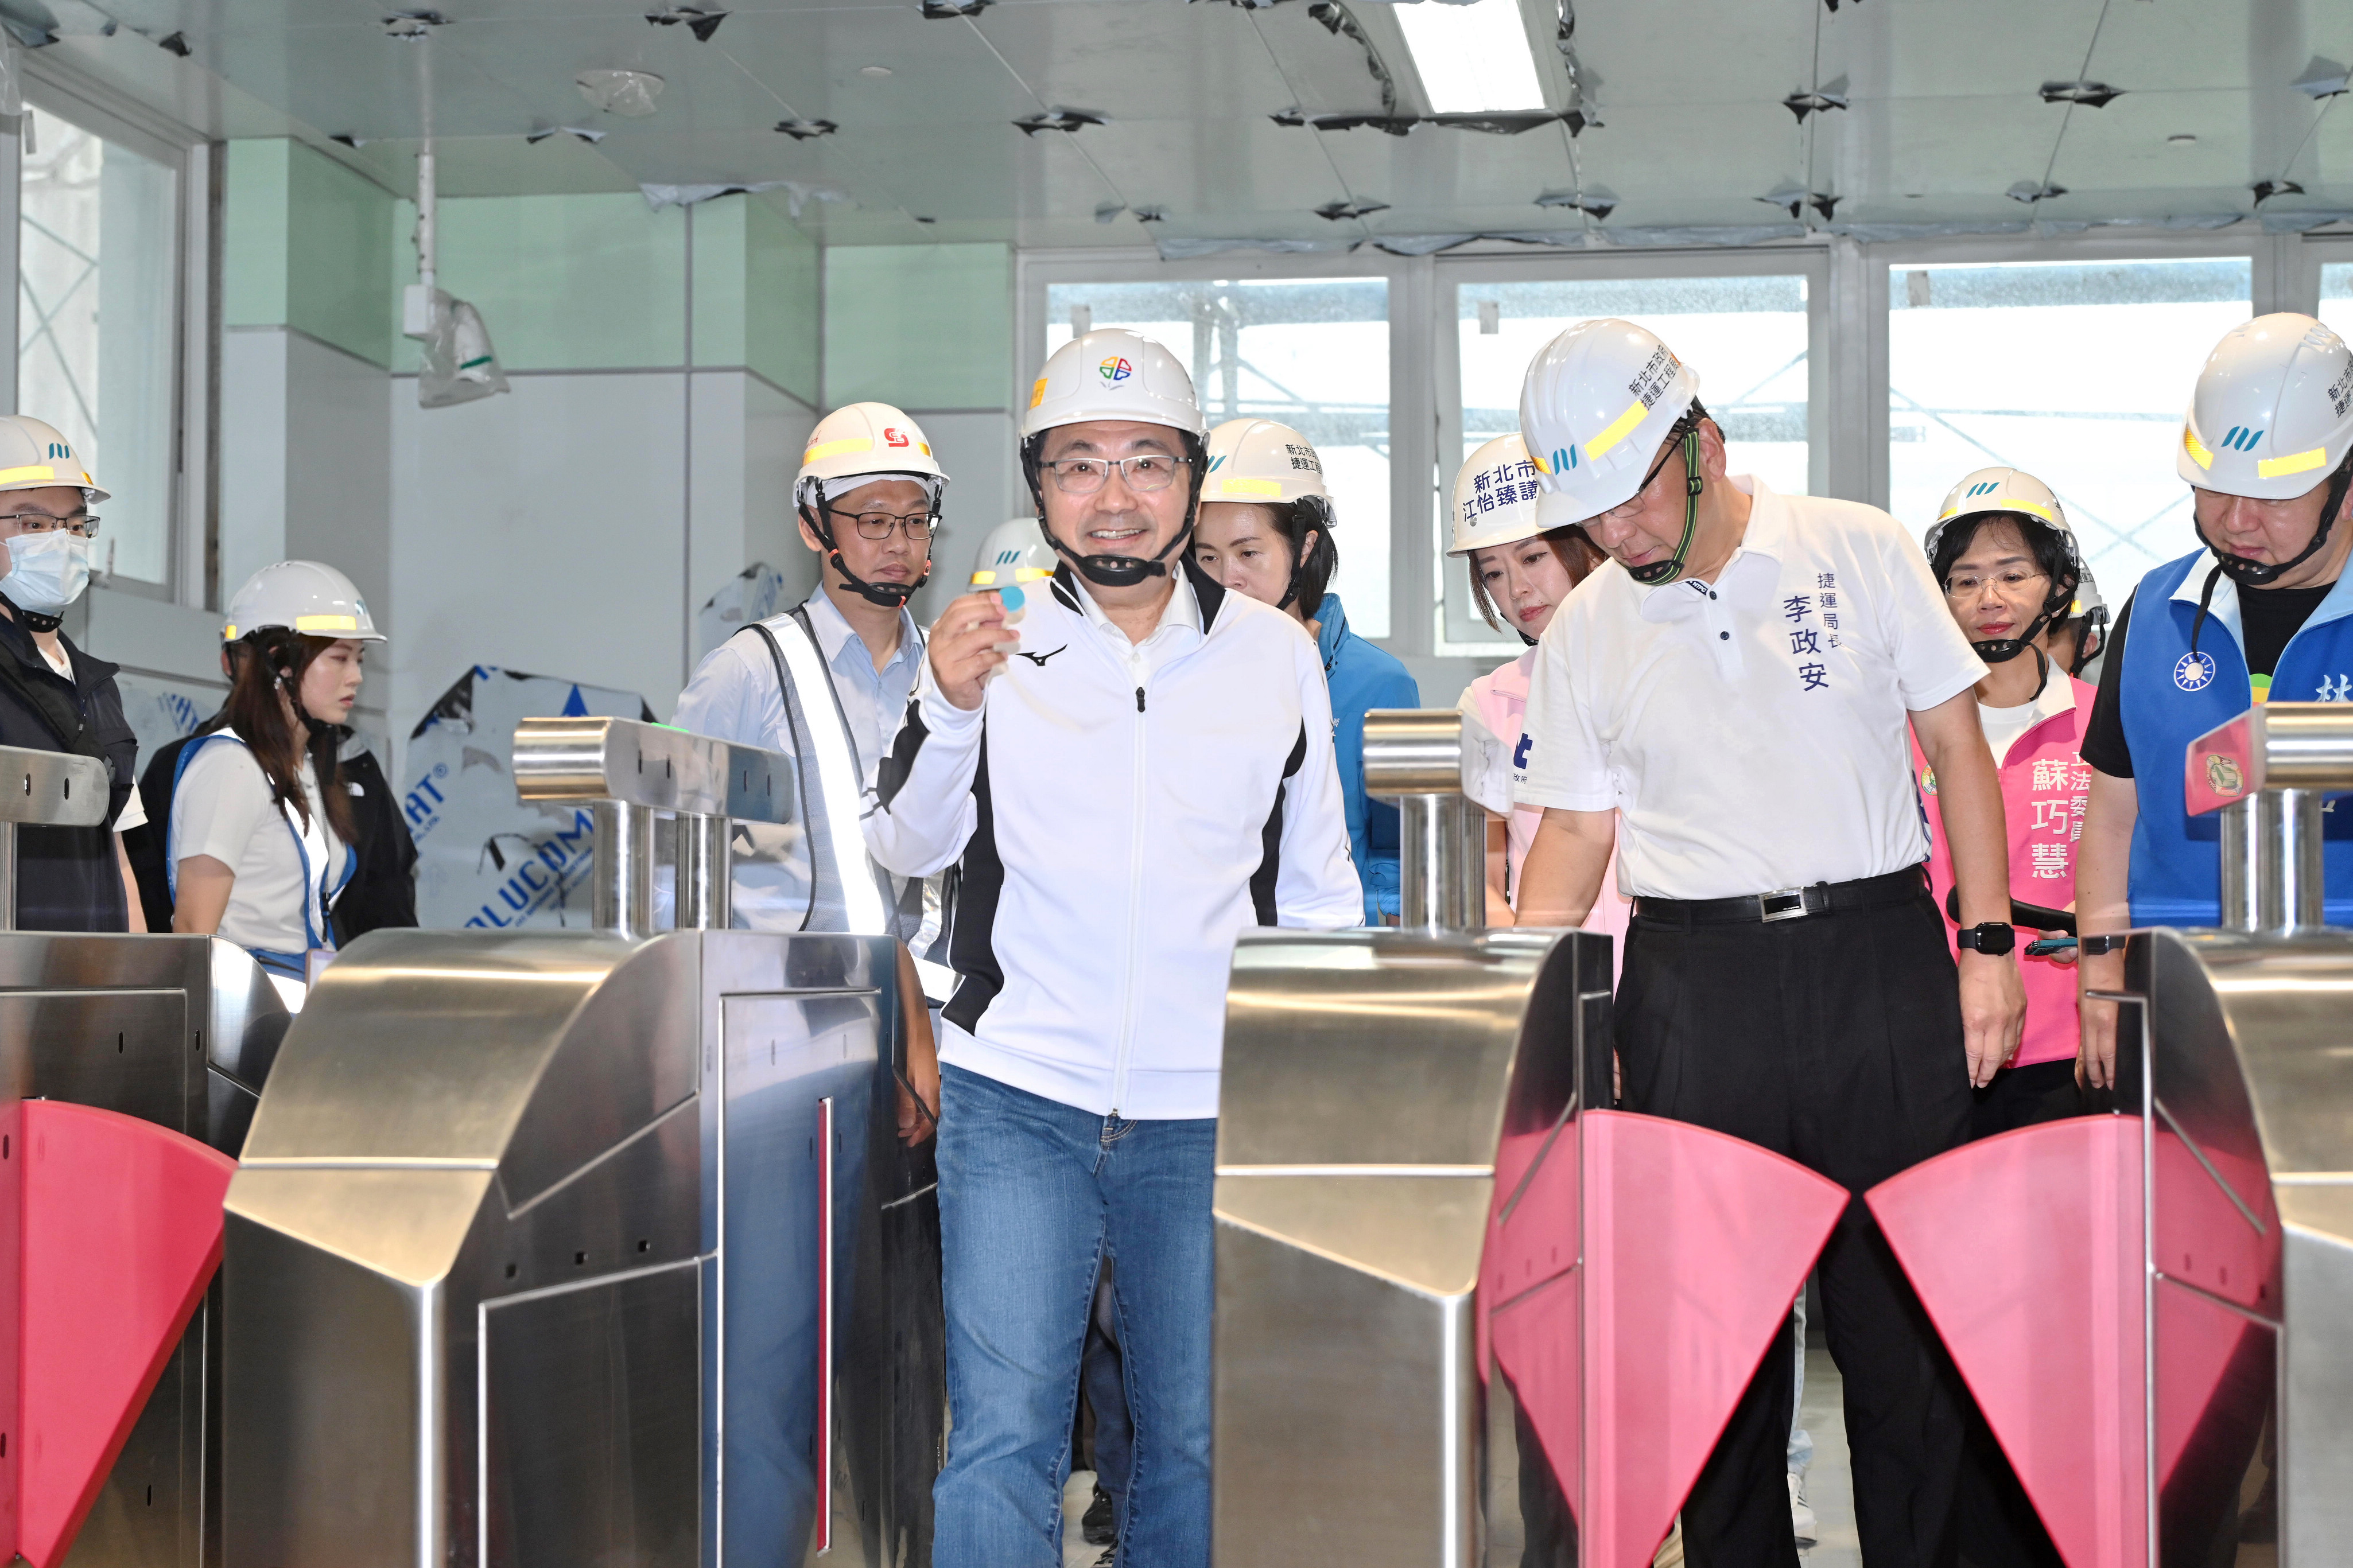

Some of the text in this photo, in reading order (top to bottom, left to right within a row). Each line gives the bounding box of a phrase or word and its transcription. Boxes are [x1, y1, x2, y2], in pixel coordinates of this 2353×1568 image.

[1629, 344, 1668, 396] 新北市政府
[2335, 384, 2353, 418] 捷運
[1462, 479, 1538, 522] 江怡臻議
[1473, 460, 1535, 494] 新北市
[1783, 596, 1830, 692] 李政安
[1817, 573, 1845, 648] 捷運局長
[2030, 758, 2069, 880] 蘇巧慧
[2069, 752, 2092, 843] 立法委員
[463, 808, 594, 928] LUCOM
